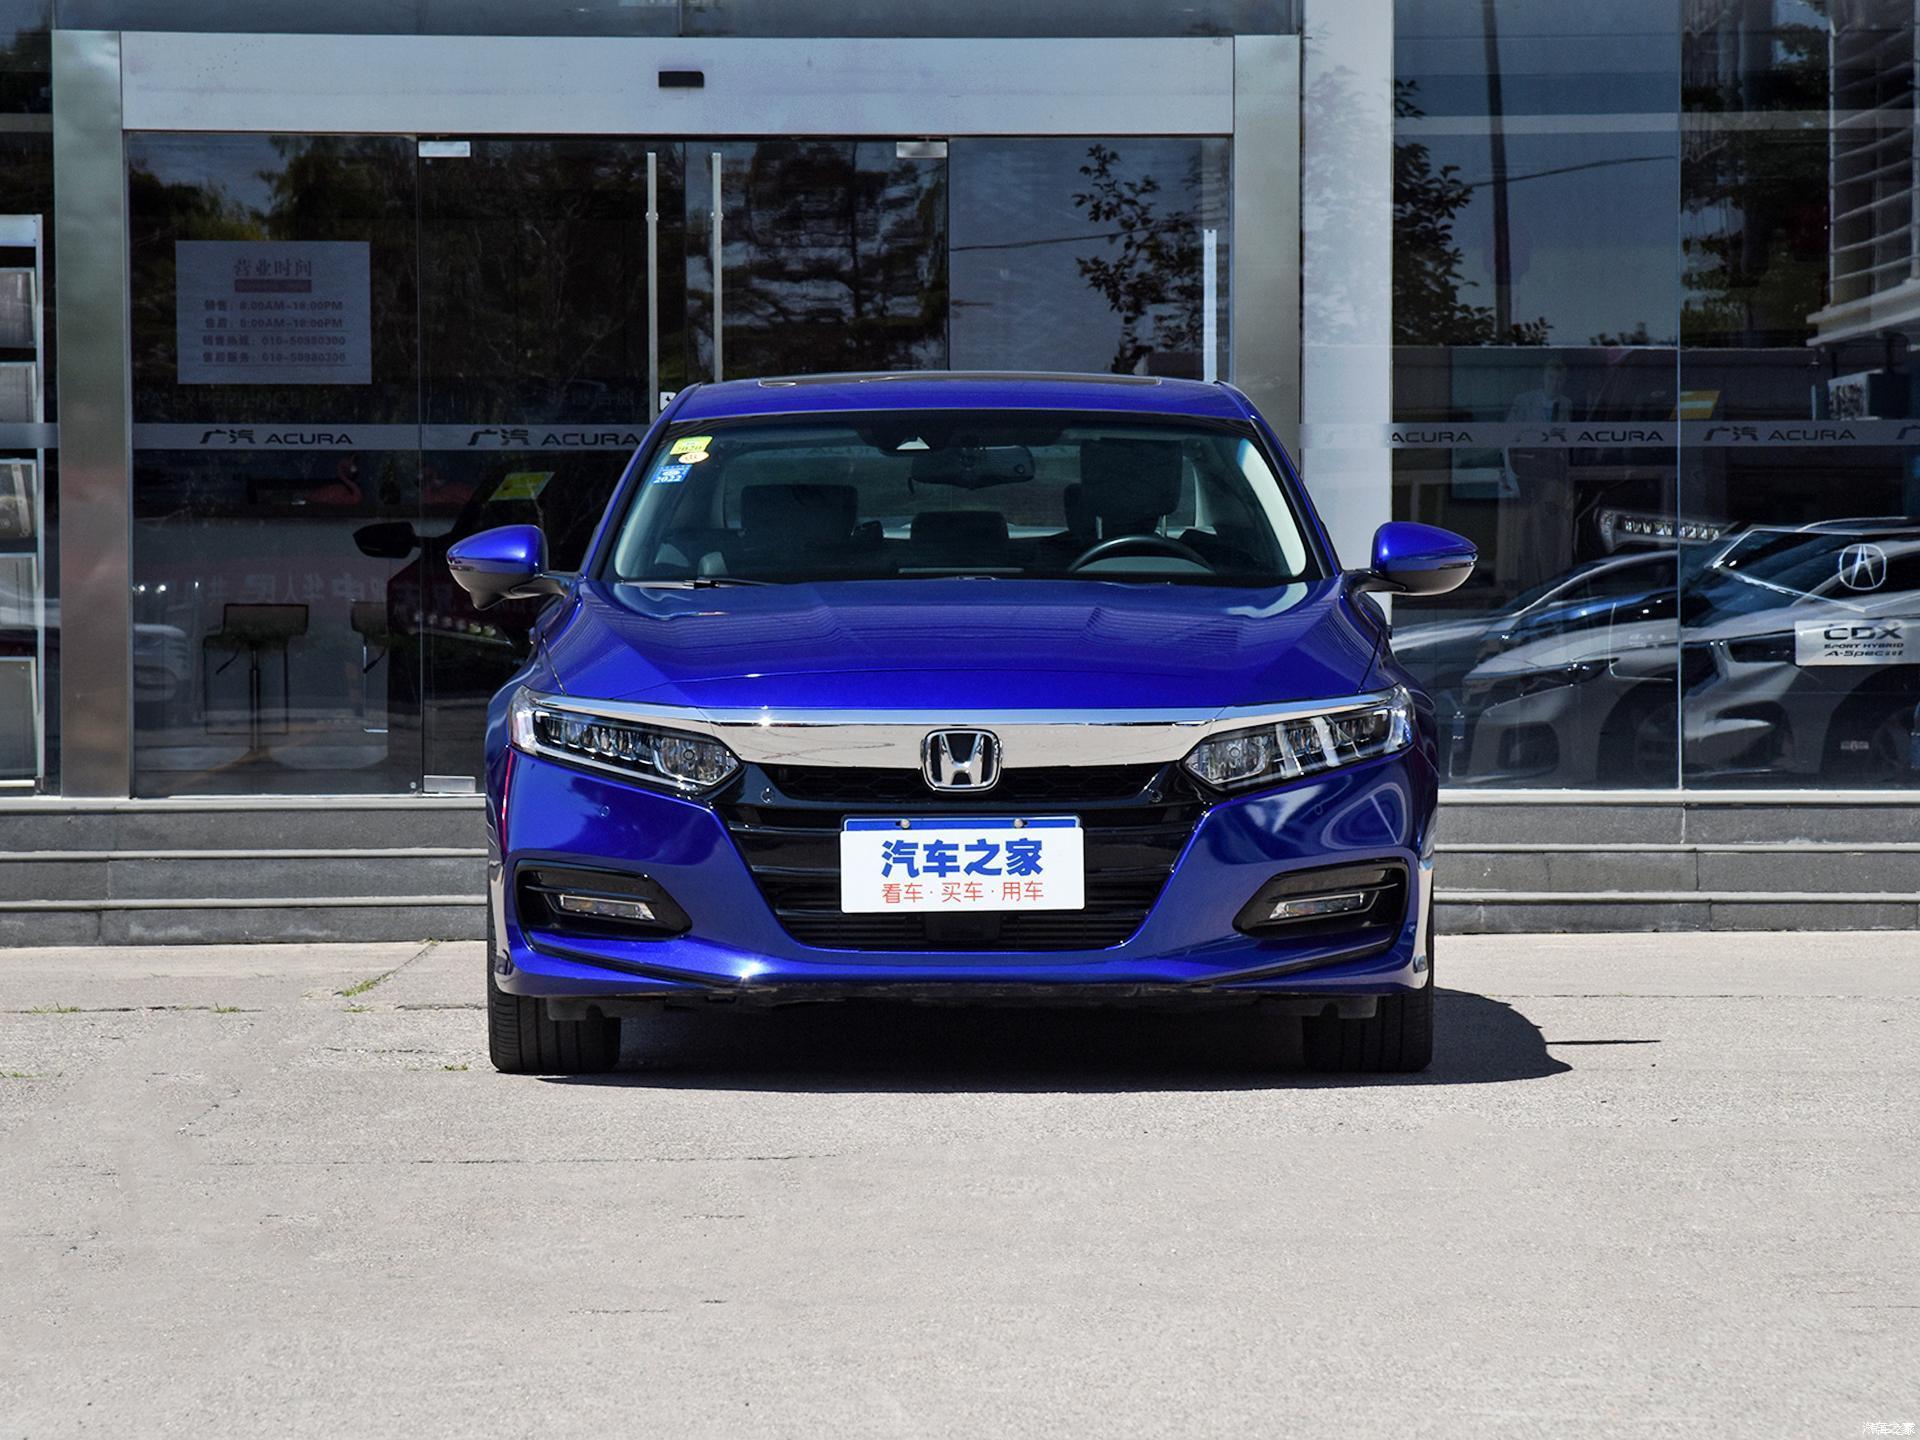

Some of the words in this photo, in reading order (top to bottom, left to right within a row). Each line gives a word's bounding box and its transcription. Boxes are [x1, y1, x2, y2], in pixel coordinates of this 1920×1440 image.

[233, 258, 312, 277] 营业时间
[200, 429, 256, 444] 广汽
[264, 432, 354, 445] ACURA
[468, 428, 530, 446] 广汽
[541, 432, 641, 446] ACURA
[1391, 431, 1473, 443] ACURA
[1577, 430, 1664, 442] ACURA
[1704, 426, 1760, 442] 广汽
[1767, 428, 1857, 441] ACURA
[1824, 627, 1903, 640] CDX
[881, 838, 1043, 878] 汽车之家
